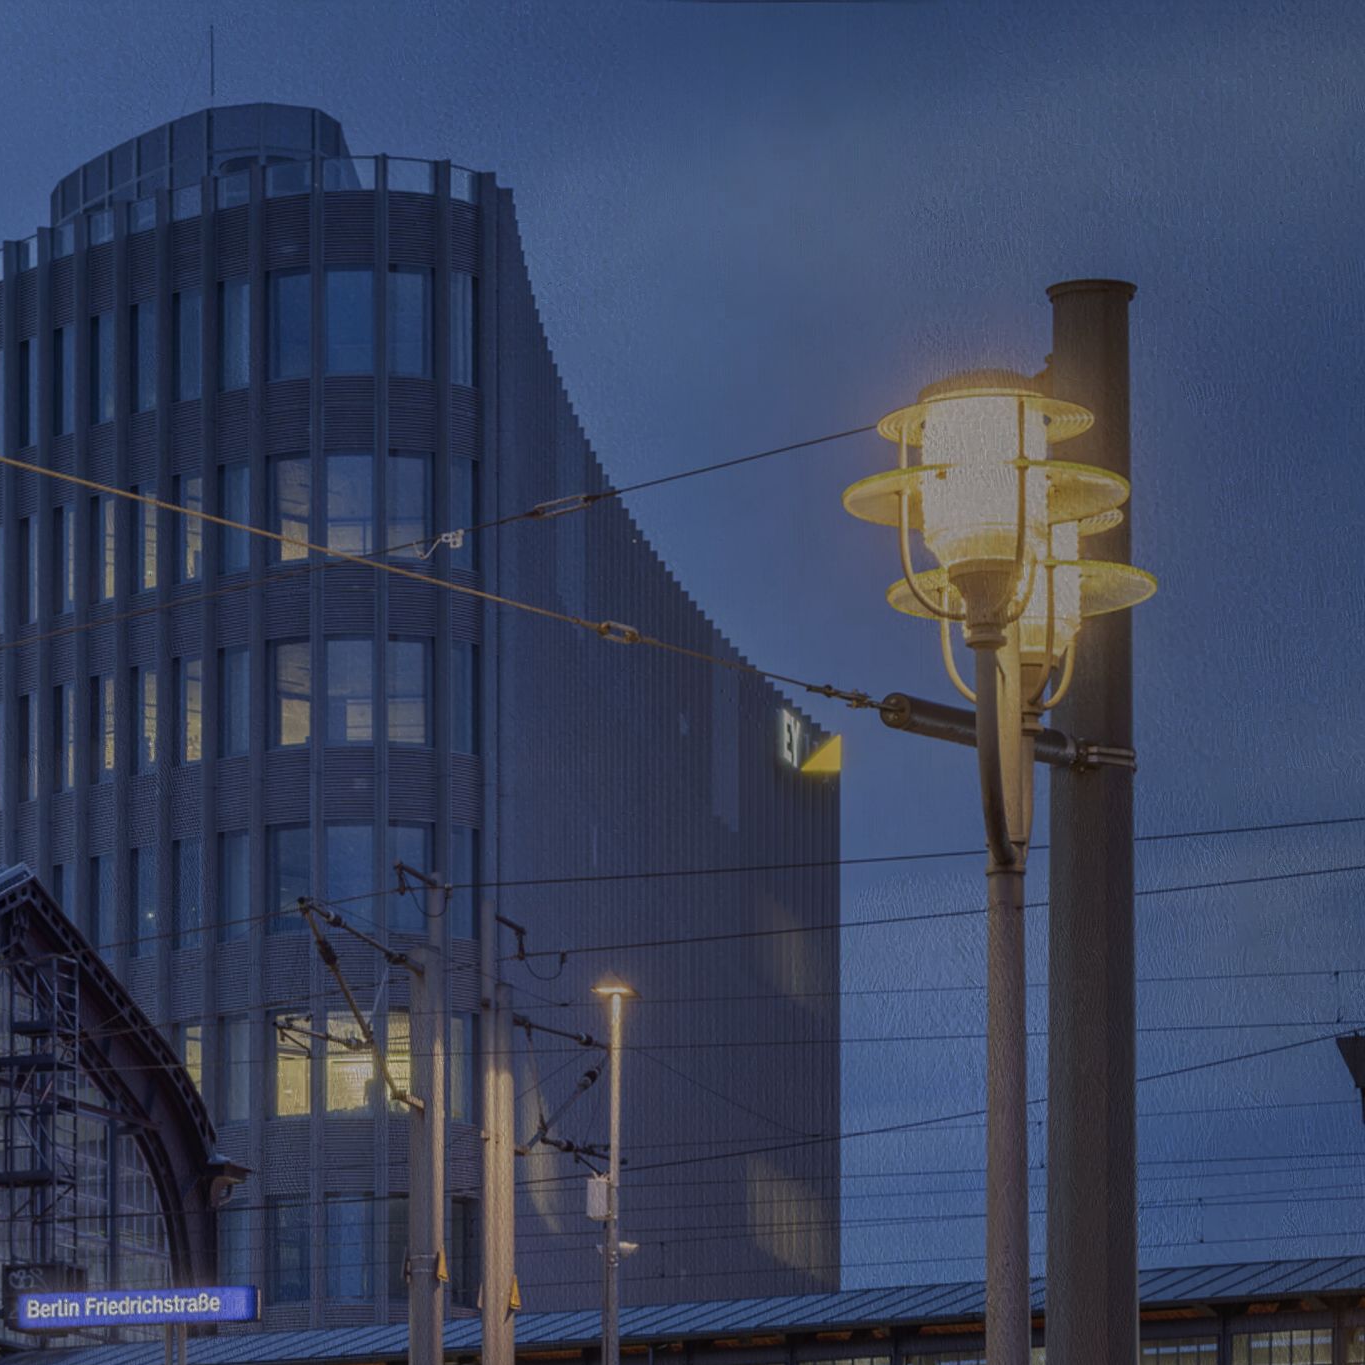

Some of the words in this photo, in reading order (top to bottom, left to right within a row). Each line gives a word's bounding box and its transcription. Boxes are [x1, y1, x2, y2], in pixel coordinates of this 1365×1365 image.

[782, 708, 801, 768] EY
[26, 1299, 80, 1319] Berlin
[84, 1293, 220, 1317] Friedrichstraße
